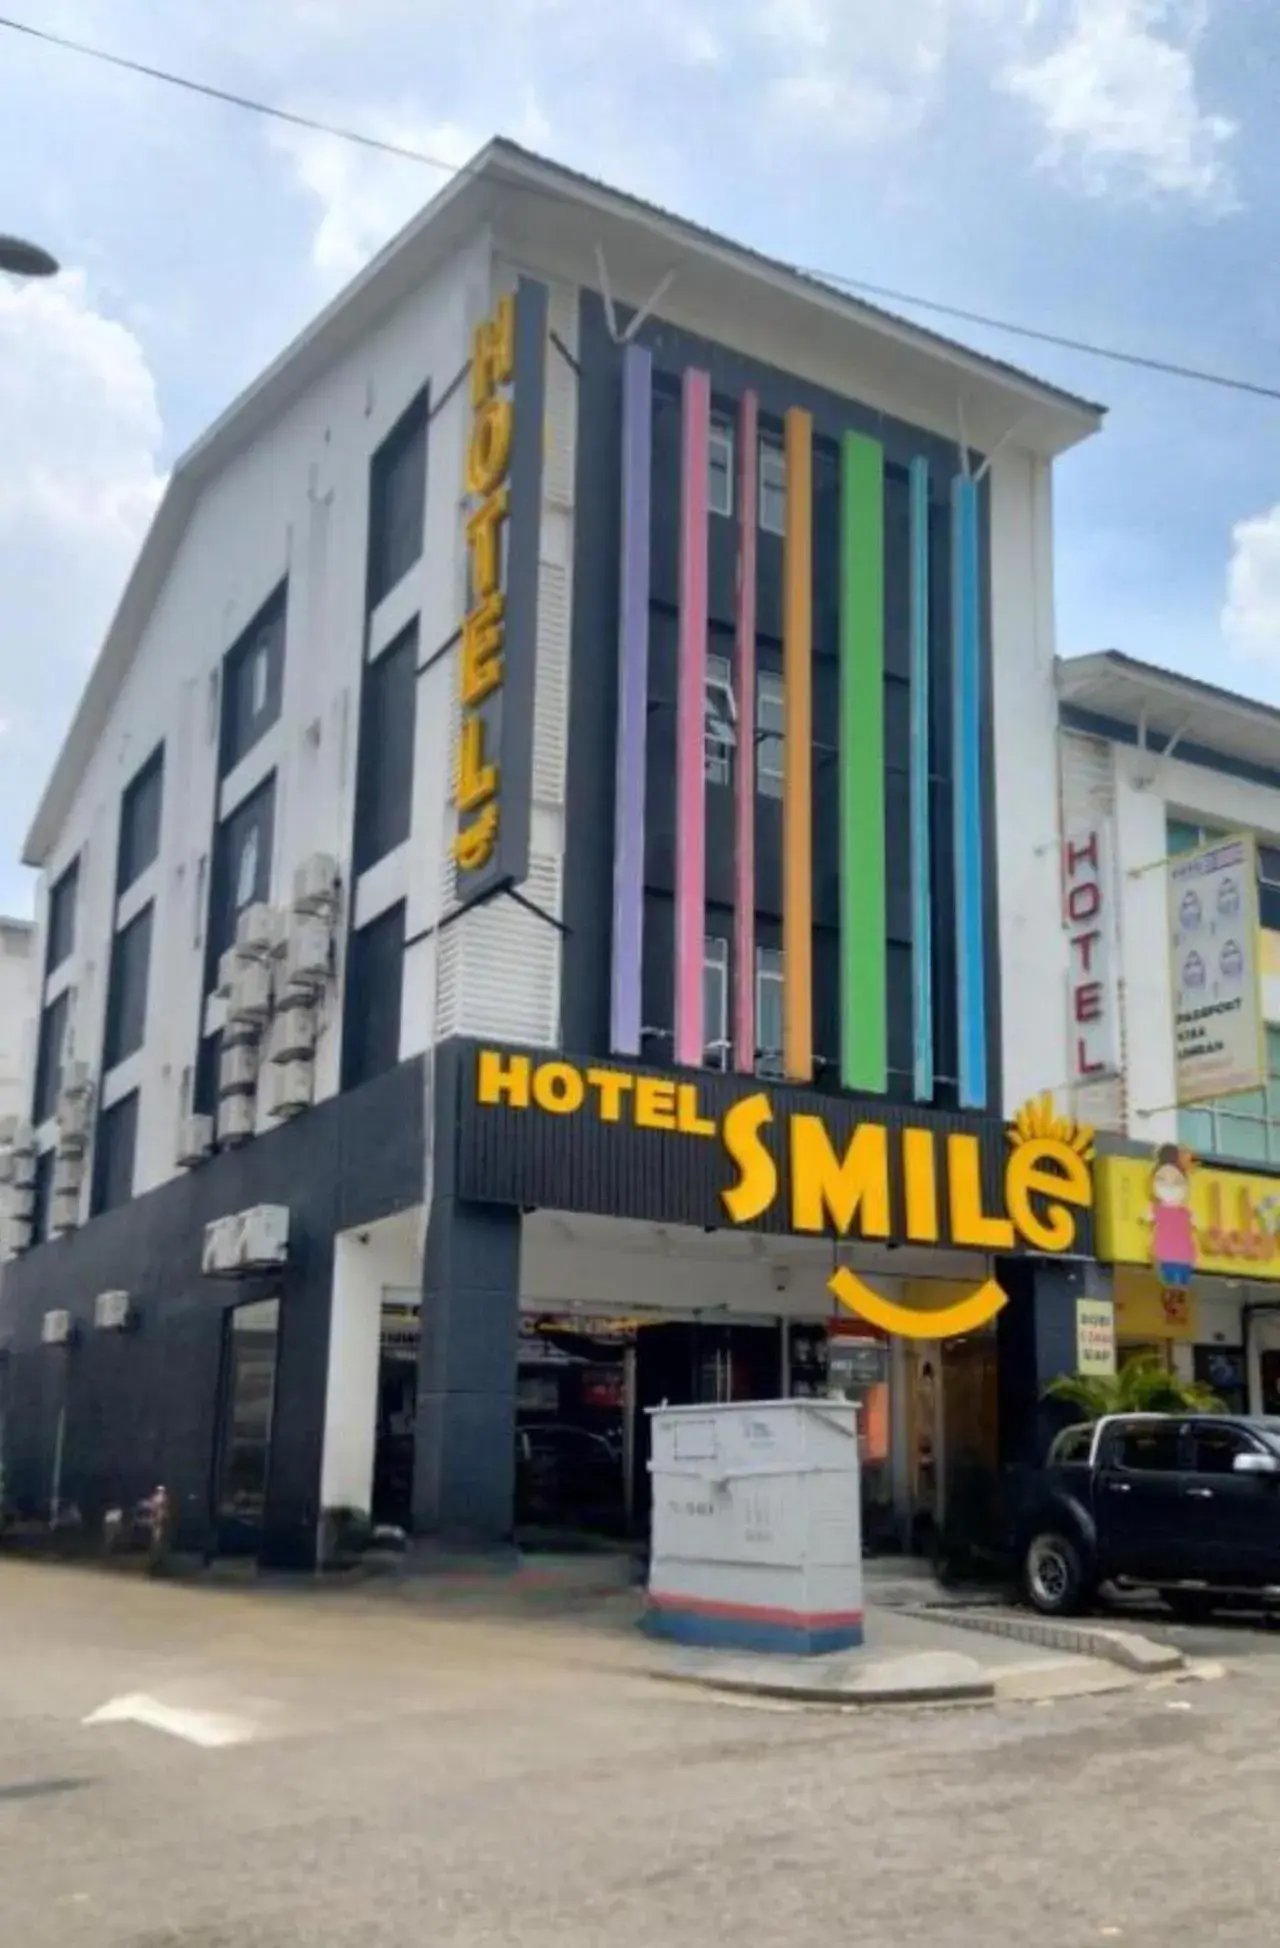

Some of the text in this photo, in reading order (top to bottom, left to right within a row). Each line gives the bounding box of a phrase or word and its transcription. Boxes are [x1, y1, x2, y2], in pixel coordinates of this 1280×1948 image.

[457, 293, 515, 811] HOTEL
[1067, 831, 1103, 1075] HOTEL
[477, 1050, 717, 1136] HOTEL
